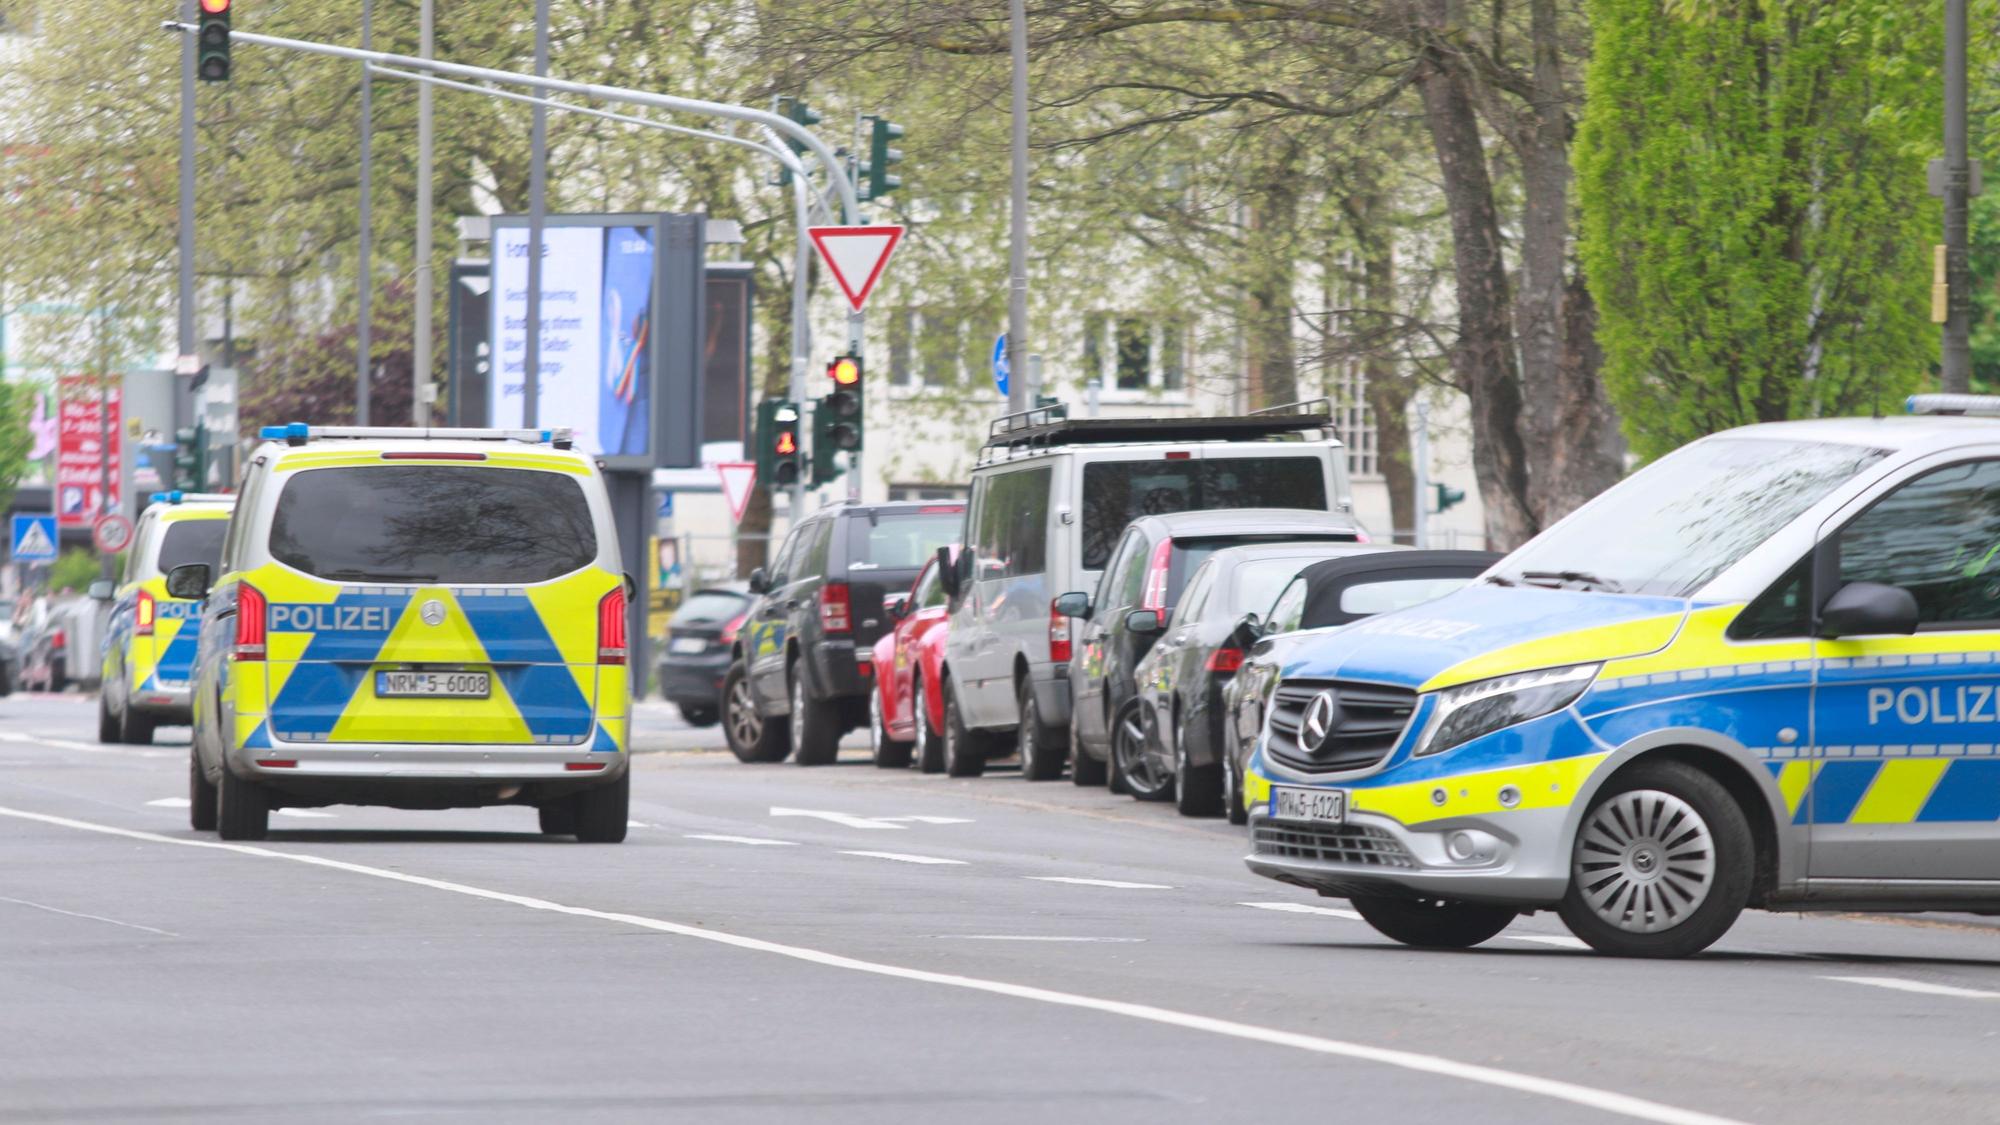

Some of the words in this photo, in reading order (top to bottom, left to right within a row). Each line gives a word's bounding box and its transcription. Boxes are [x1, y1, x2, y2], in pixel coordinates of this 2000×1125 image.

[271, 606, 389, 630] POLIZEI
[387, 675, 417, 691] NRW
[427, 675, 487, 692] 5-6008
[1868, 685, 2000, 725] POLIZ
[1299, 793, 1340, 819] 5-6120
